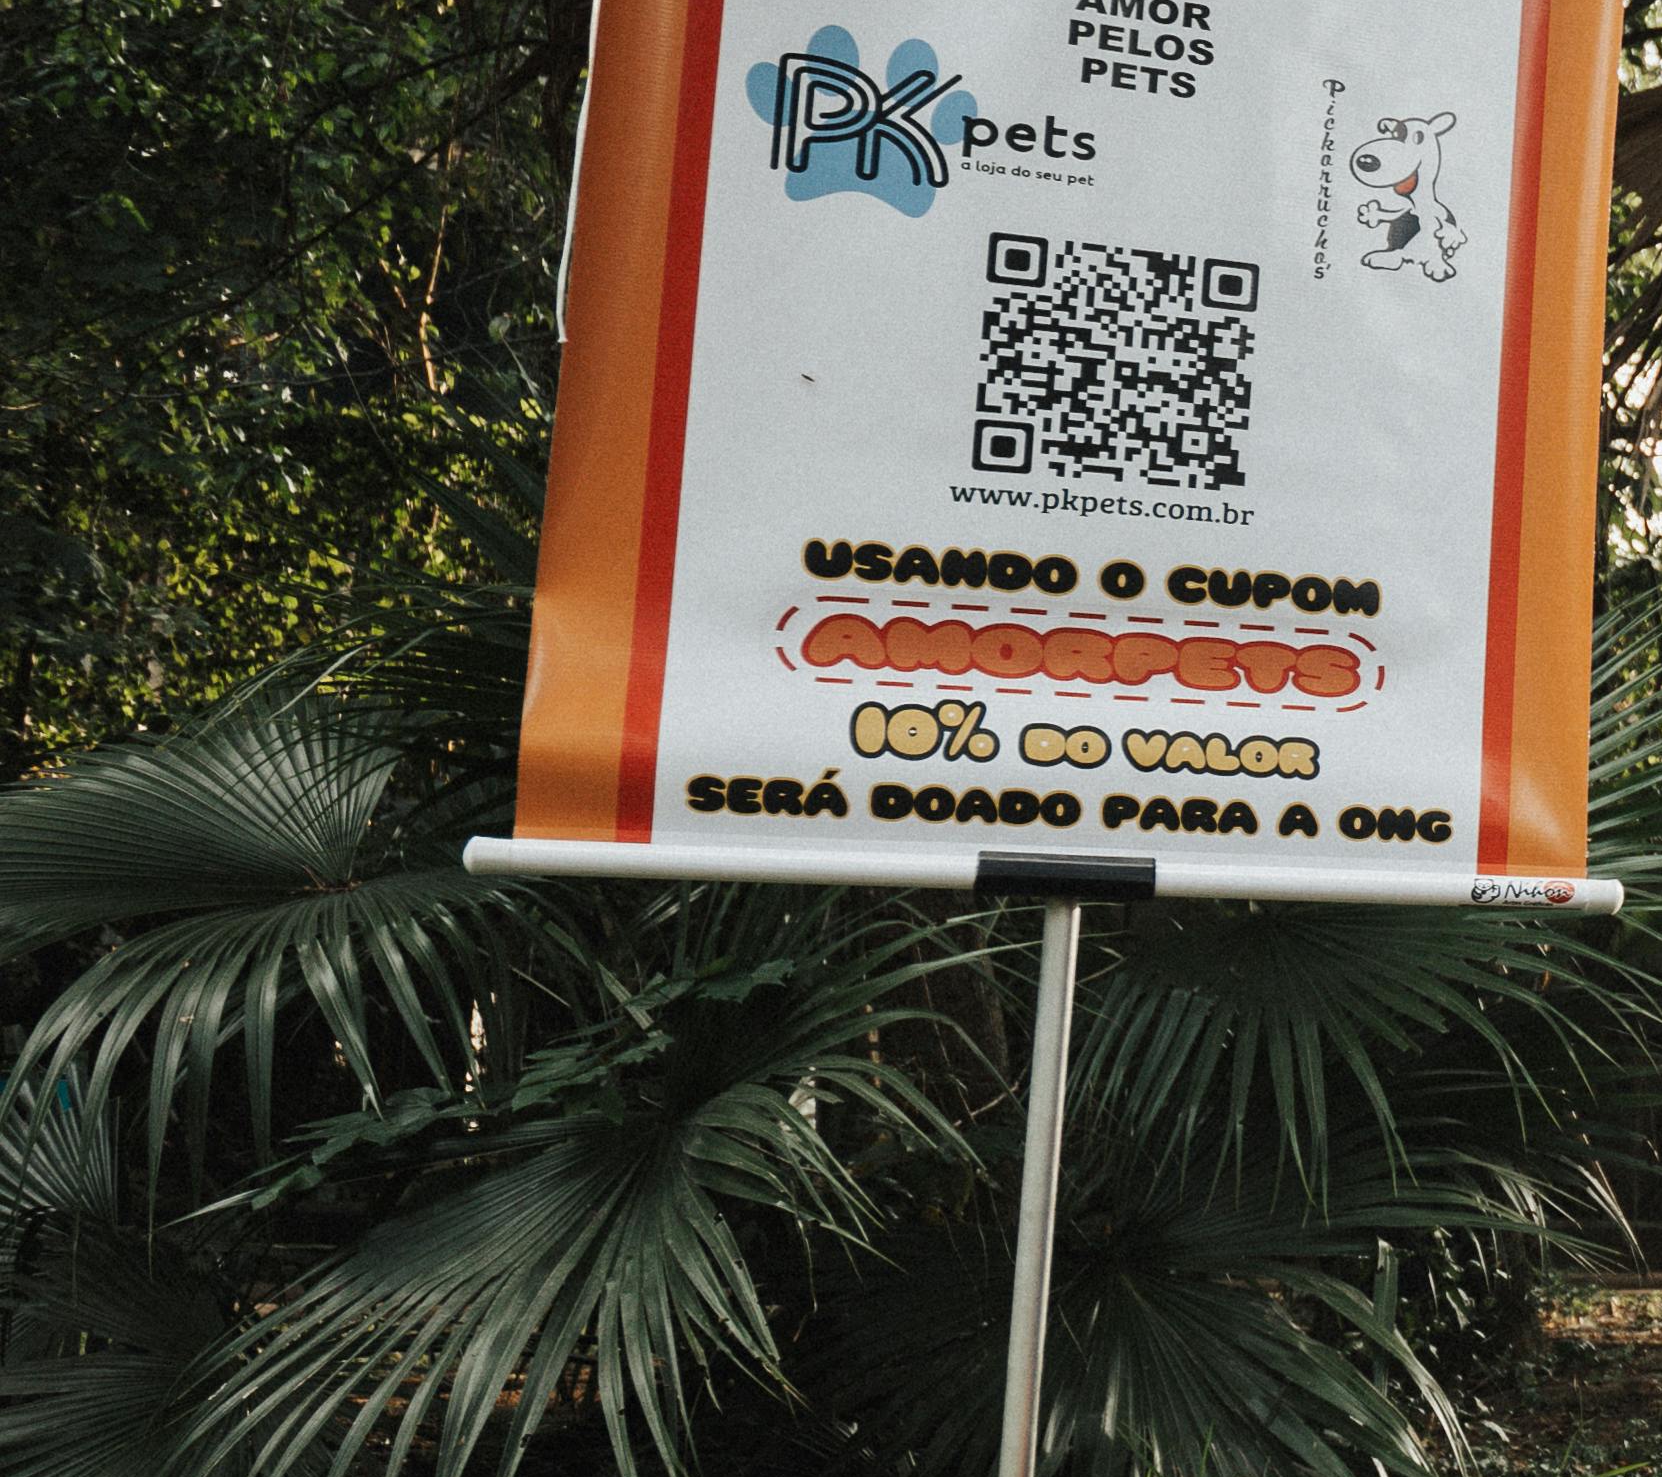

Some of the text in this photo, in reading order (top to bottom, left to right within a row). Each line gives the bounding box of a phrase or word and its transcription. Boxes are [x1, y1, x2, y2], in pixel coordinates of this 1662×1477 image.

[1067, 19, 1215, 67] PELOS
[1080, 57, 1198, 99] PETS
[770, 52, 1097, 189] PK pets
[961, 160, 1095, 188] a loja do seu pet
[949, 484, 1255, 526] www.pkpets.com.br
[801, 538, 1384, 619] USANDO O CUPOM
[800, 613, 1363, 698] AMORPETS
[849, 699, 1320, 781] 10% DO VALOR
[684, 768, 1454, 846] SERÁ DOADO PARA A ONG
